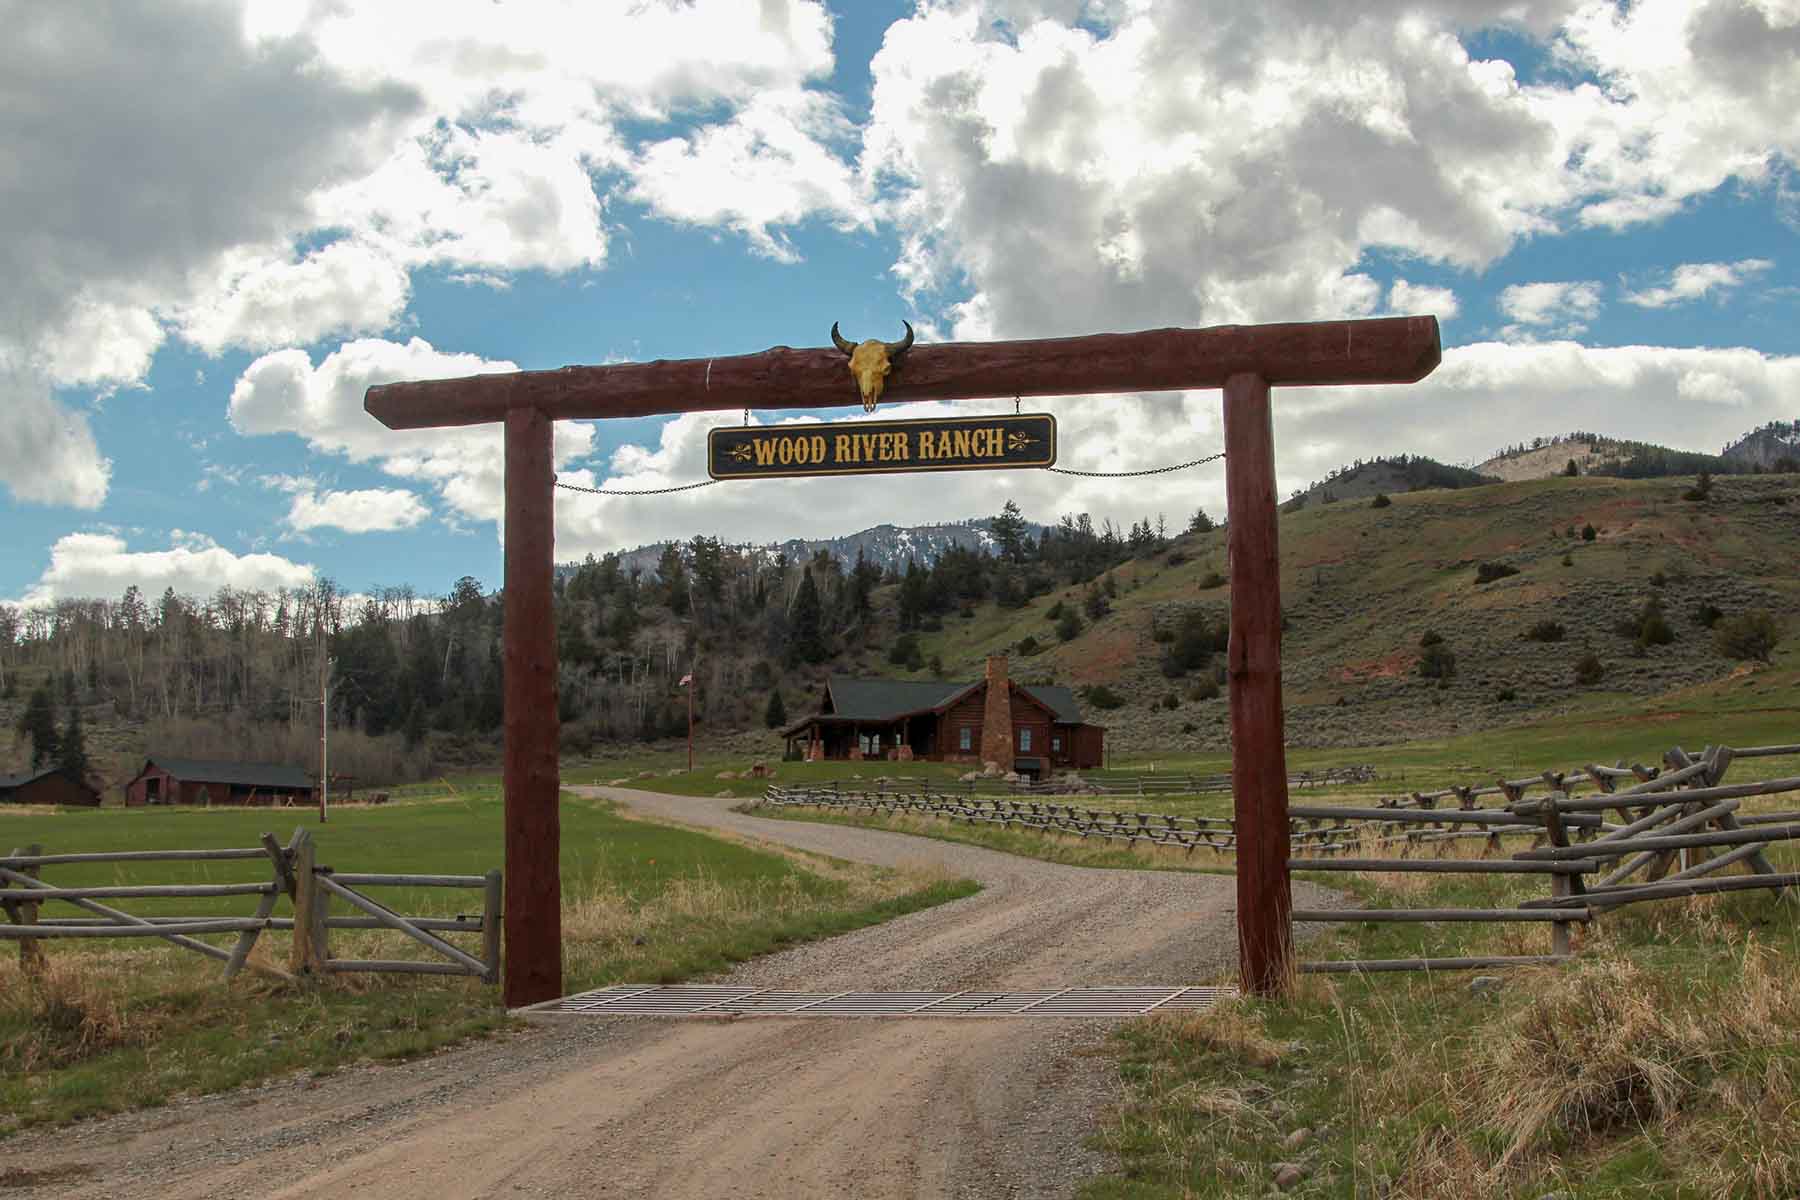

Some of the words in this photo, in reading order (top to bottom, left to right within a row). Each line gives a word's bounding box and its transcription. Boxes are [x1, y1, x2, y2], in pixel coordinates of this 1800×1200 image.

[753, 435, 826, 466] WOOD
[834, 431, 909, 463] RIVER
[918, 428, 1005, 460] RANCH
